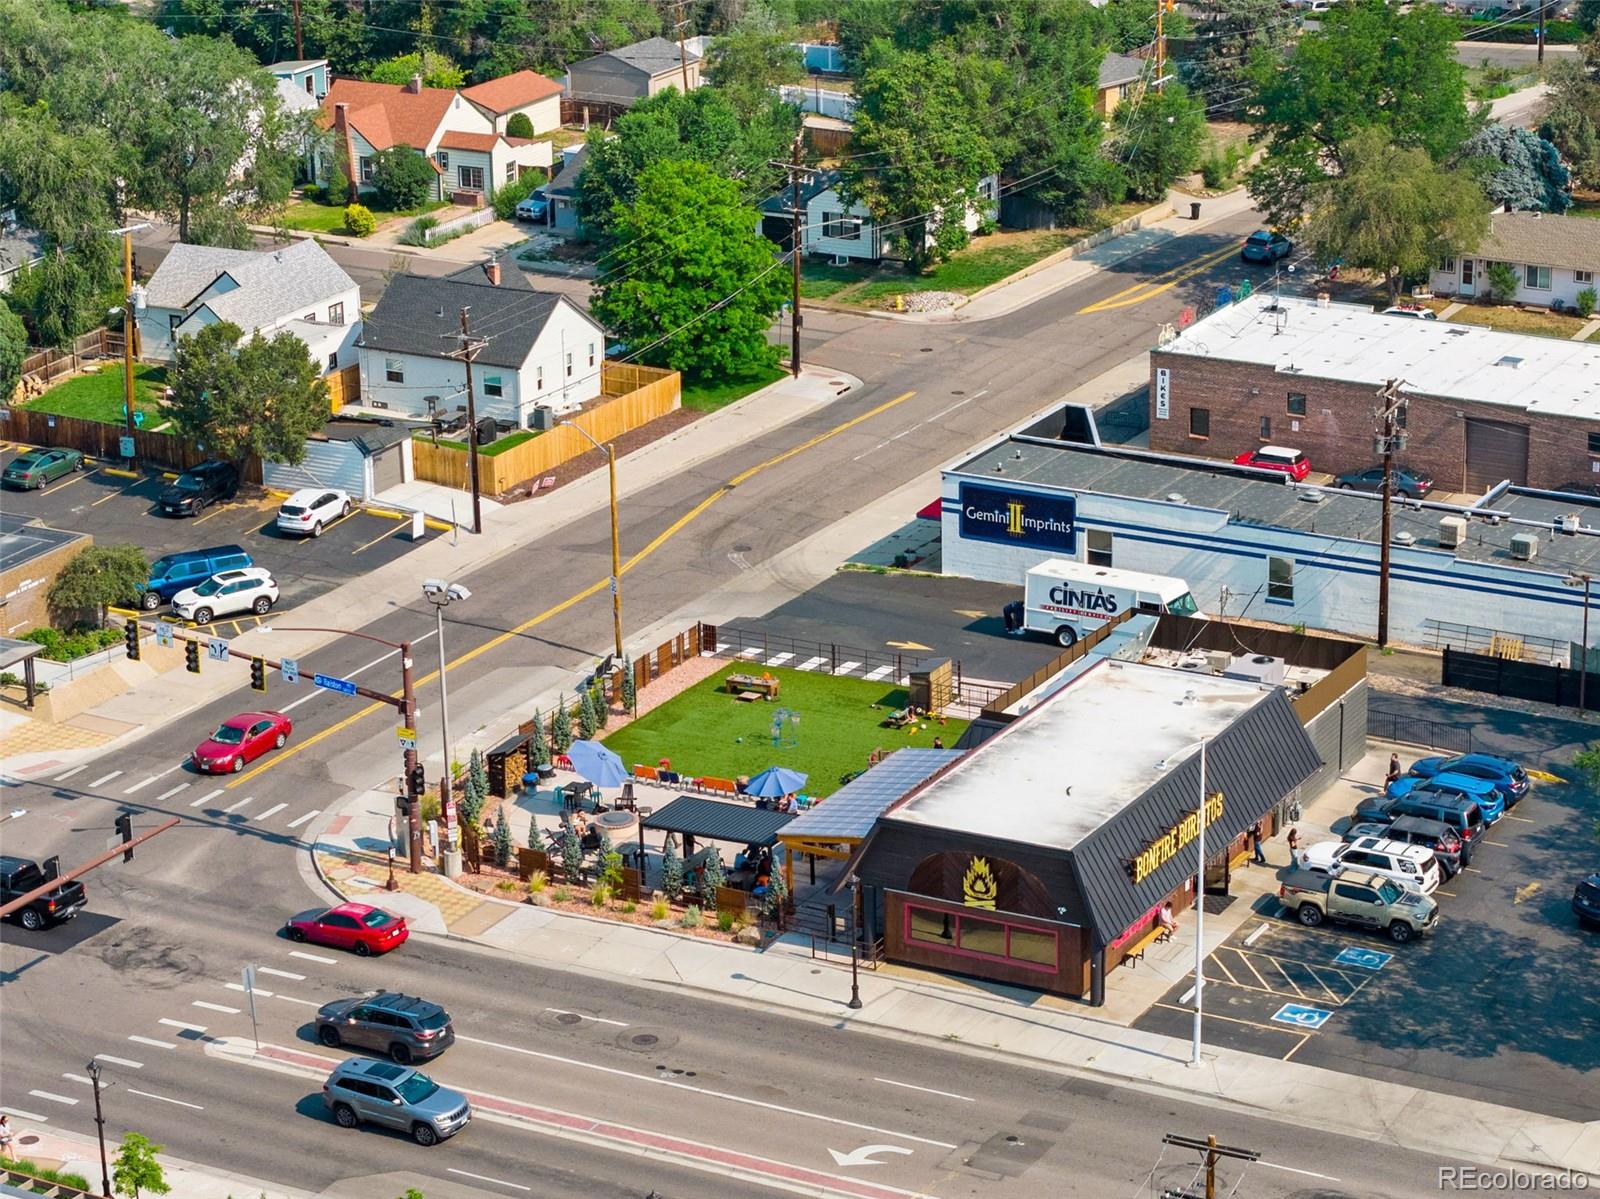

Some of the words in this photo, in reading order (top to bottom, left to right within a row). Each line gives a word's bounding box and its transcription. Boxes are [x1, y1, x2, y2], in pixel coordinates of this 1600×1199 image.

[966, 506, 1009, 525] Gemini
[1021, 514, 1071, 534] Imprints
[1049, 582, 1118, 613] CINTAS
[1136, 826, 1178, 884] BONFIRE
[1178, 792, 1223, 849] BURTOS
